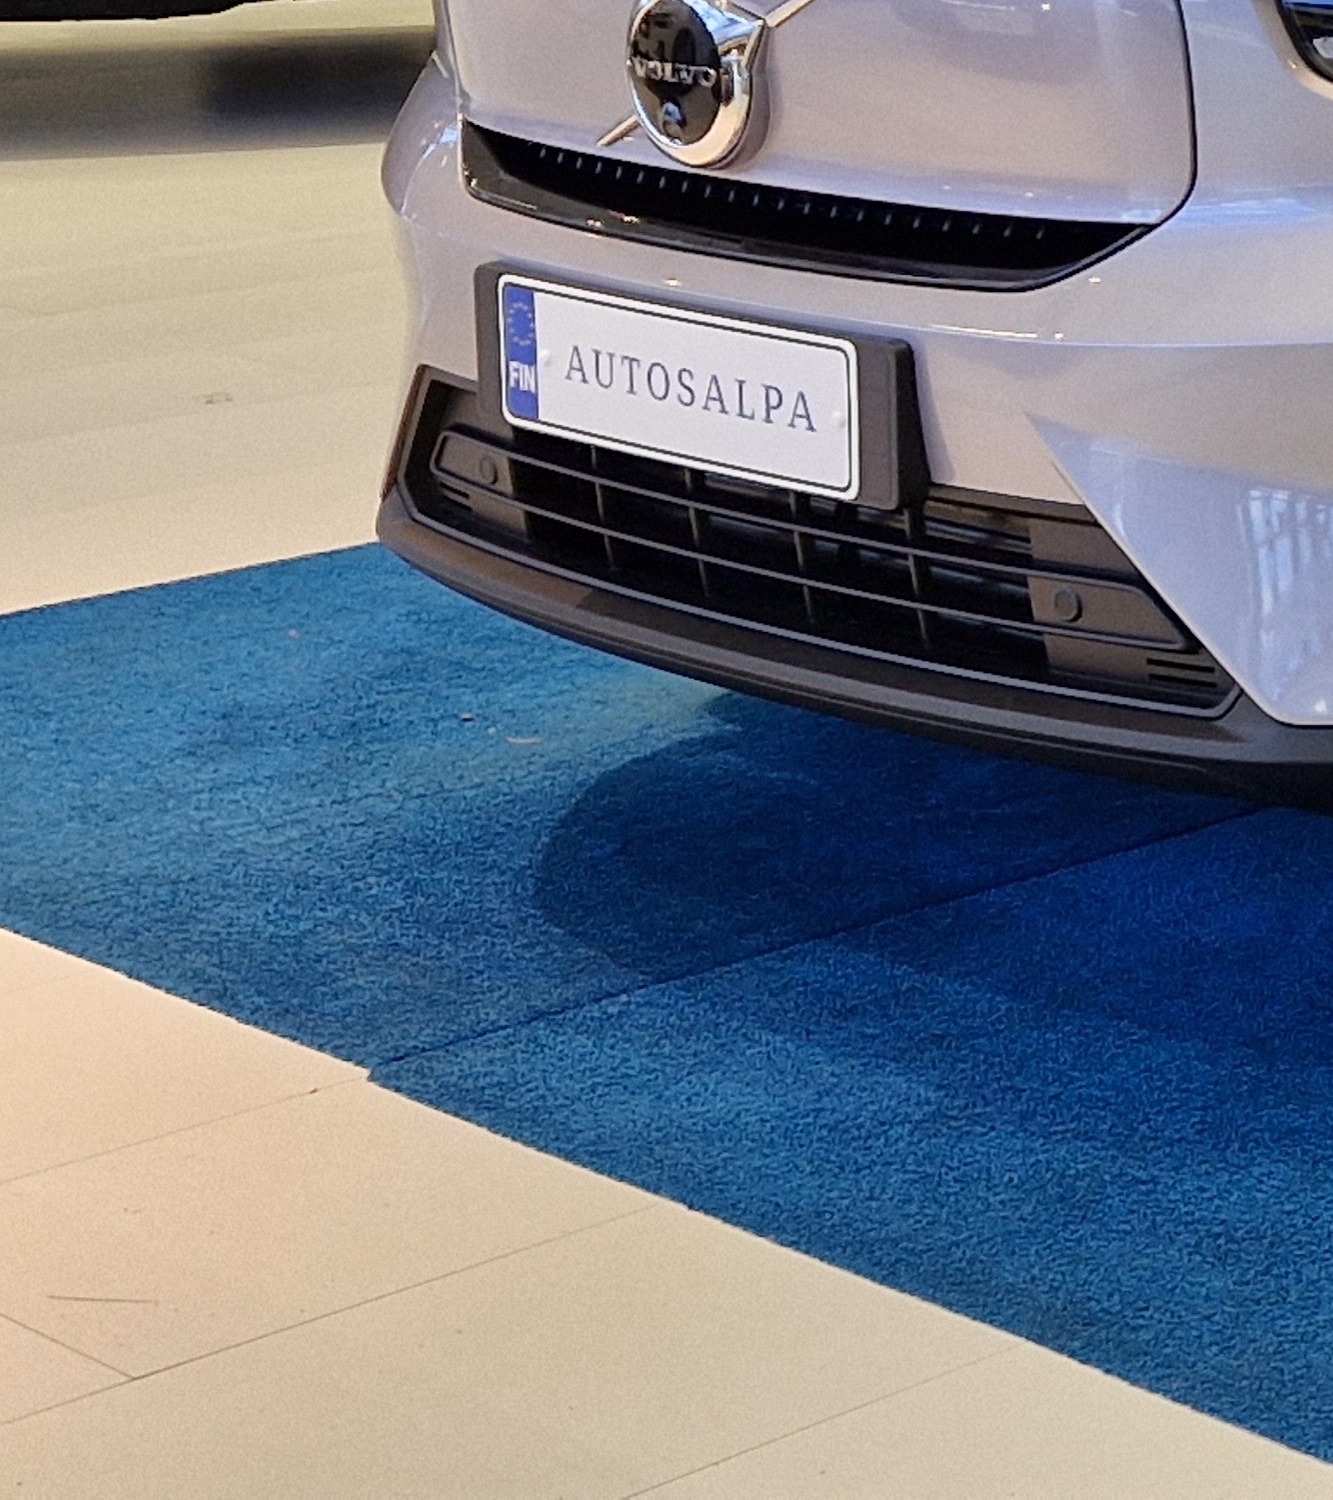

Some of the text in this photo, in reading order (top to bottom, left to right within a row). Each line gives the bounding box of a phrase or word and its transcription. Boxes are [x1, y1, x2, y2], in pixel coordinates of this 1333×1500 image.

[629, 57, 718, 88] VOLVO
[508, 345, 817, 432] FIN AUTOSALPA
